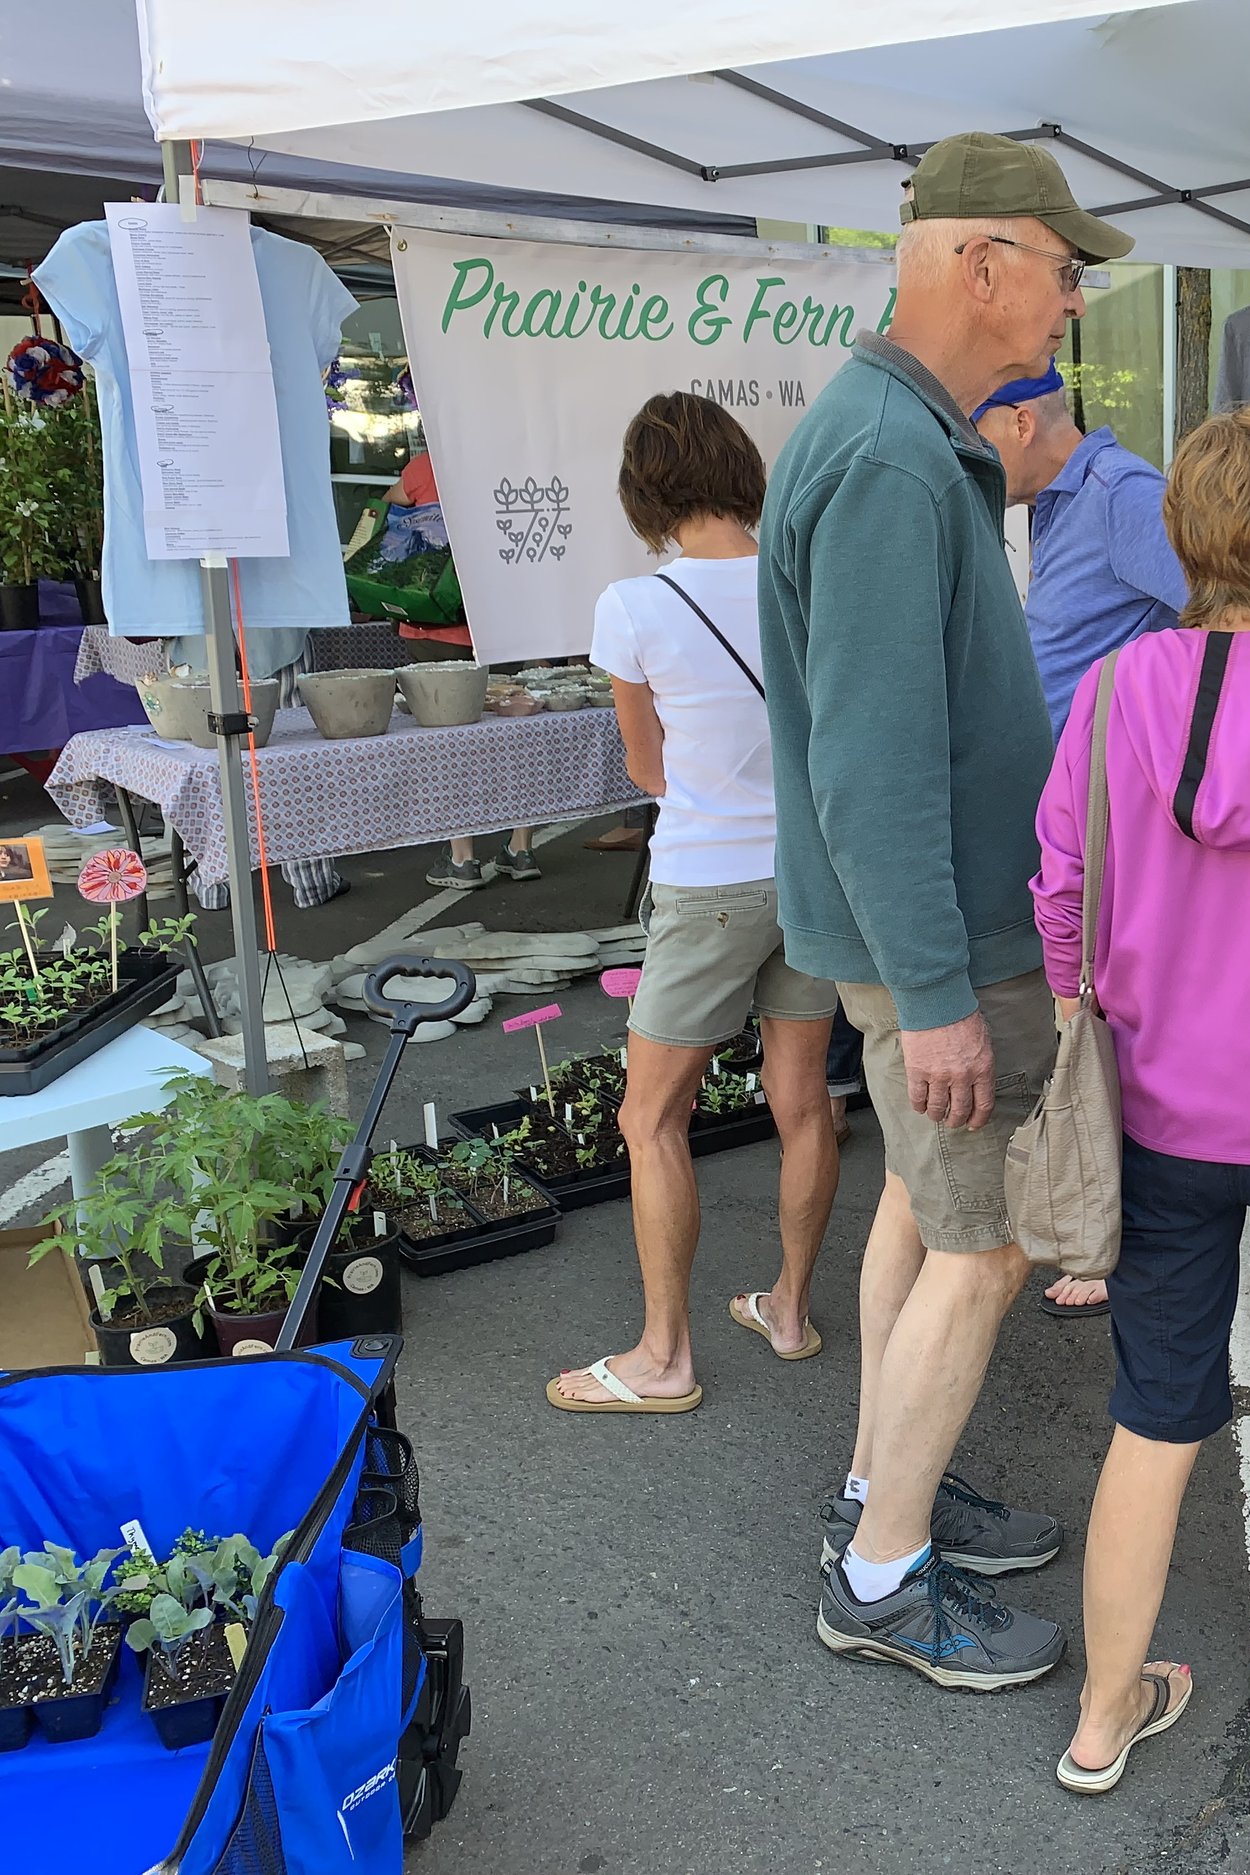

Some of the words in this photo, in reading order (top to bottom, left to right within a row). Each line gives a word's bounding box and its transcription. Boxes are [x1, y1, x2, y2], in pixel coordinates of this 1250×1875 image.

[441, 257, 674, 341] Prairie
[687, 274, 732, 345] &
[743, 278, 857, 348] Fern
[690, 379, 760, 406] CAMAS
[779, 380, 806, 407] WA
